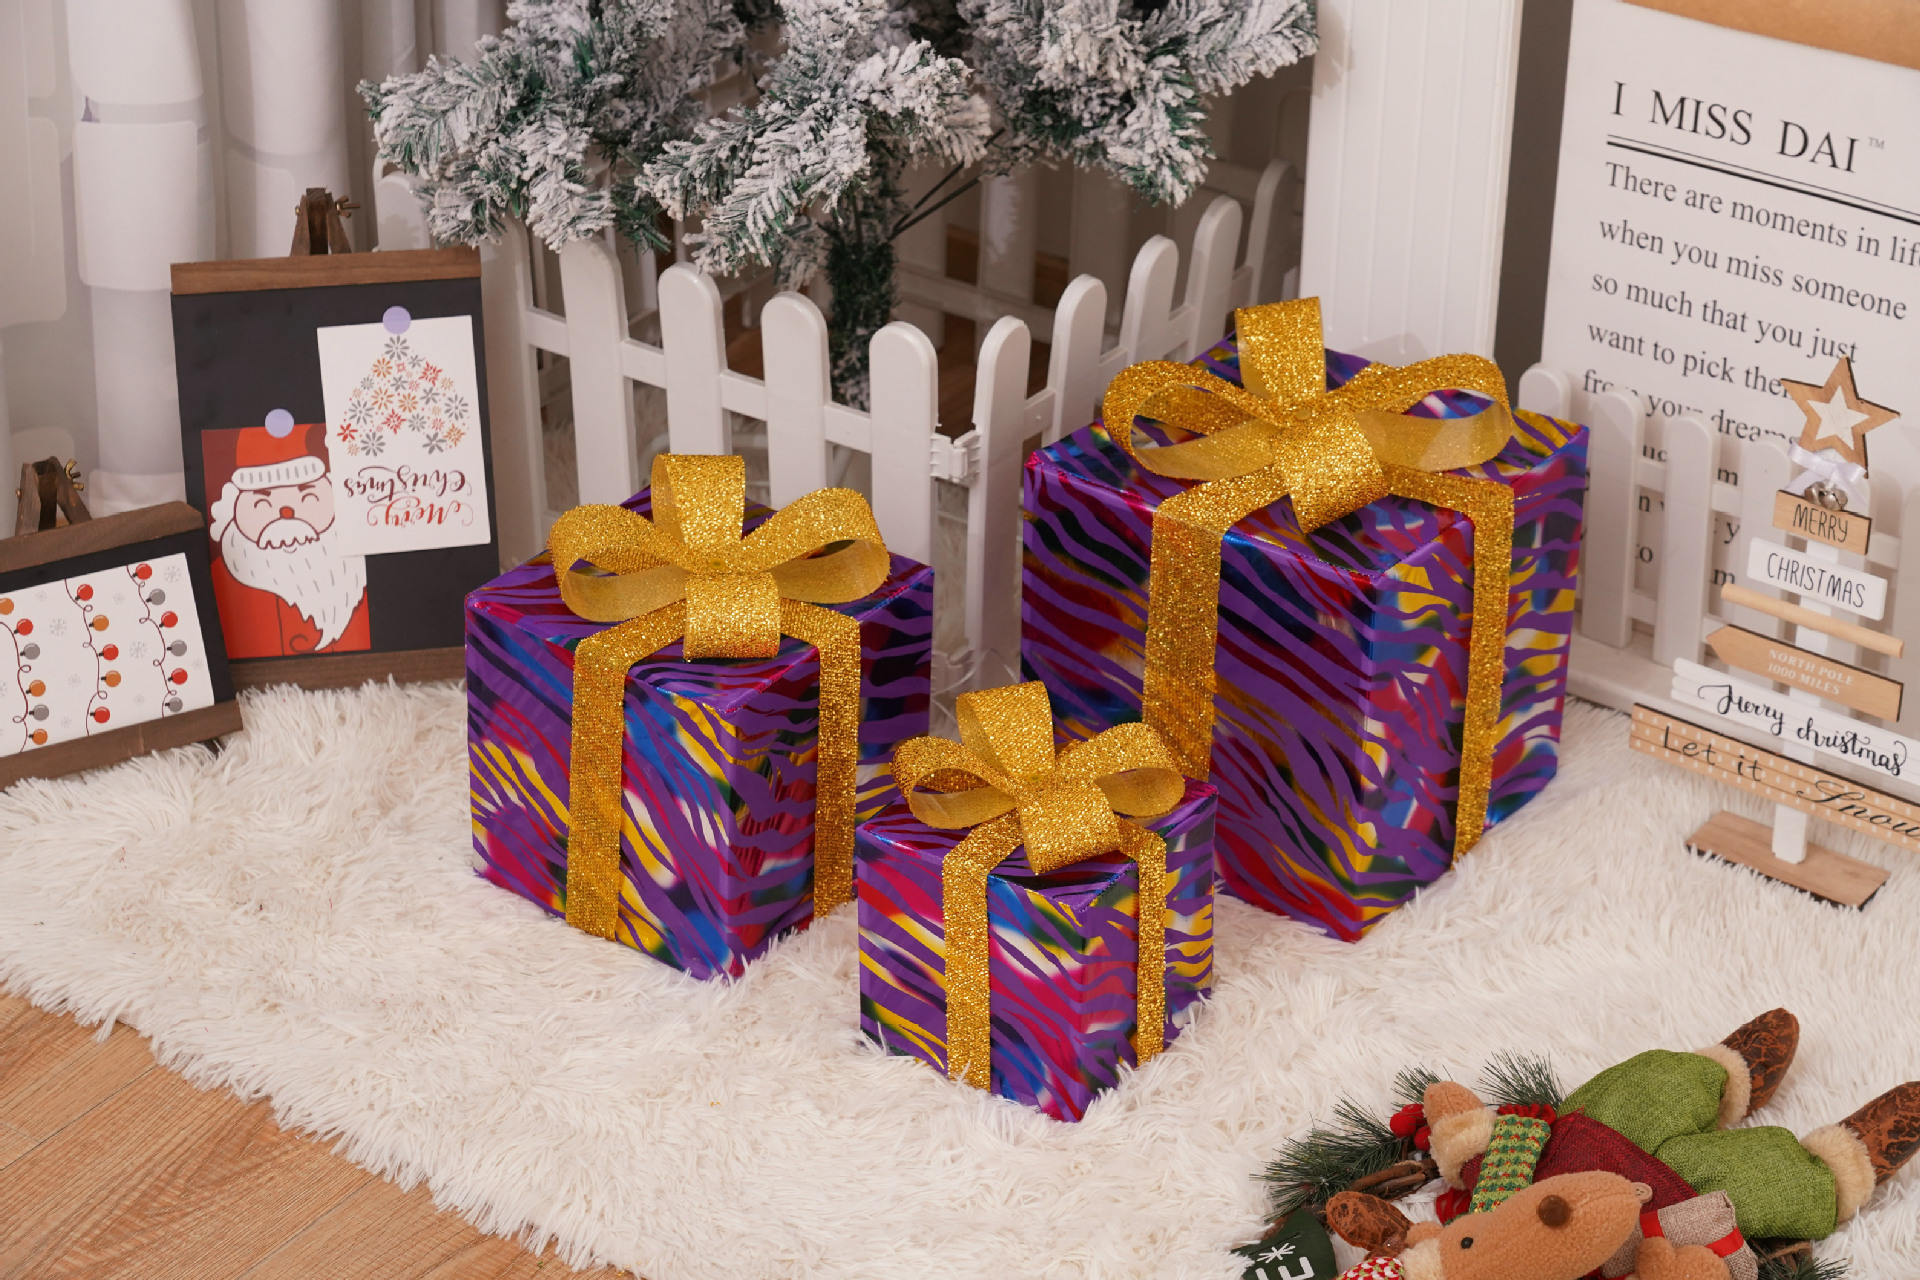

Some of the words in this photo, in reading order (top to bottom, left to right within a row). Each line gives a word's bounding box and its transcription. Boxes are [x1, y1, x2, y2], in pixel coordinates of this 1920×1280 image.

[1611, 81, 1626, 116] I
[1649, 89, 1752, 146] MISS
[1777, 120, 1859, 173] DAI
[1606, 161, 1676, 202] There
[1684, 188, 1723, 213] are
[1730, 200, 1848, 248] moments
[1856, 227, 1880, 256] in
[1889, 236, 1920, 268] lif
[1600, 219, 1664, 254] when
[1671, 240, 1718, 269] you
[1726, 255, 1783, 287] miss
[1792, 273, 1907, 320] someone
[1592, 273, 1618, 295] so
[1626, 282, 1692, 318] much
[1702, 299, 1748, 333] that
[1754, 319, 1803, 348] you
[1806, 328, 1858, 364] just
[1588, 323, 1645, 357] want
[1653, 341, 1675, 364] to
[1683, 351, 1735, 384] pick
[1793, 503, 1849, 543] MERRY
[1767, 552, 1865, 608] CHRISTMAS
[1769, 649, 1815, 673] NORTH
[1820, 668, 1854, 686] POLE
[1799, 673, 1840, 695] MILES
[1664, 726, 1716, 766] Let
[1737, 755, 1762, 782] it
[1697, 684, 1785, 737] Merry
[1797, 717, 1907, 776] christmas
